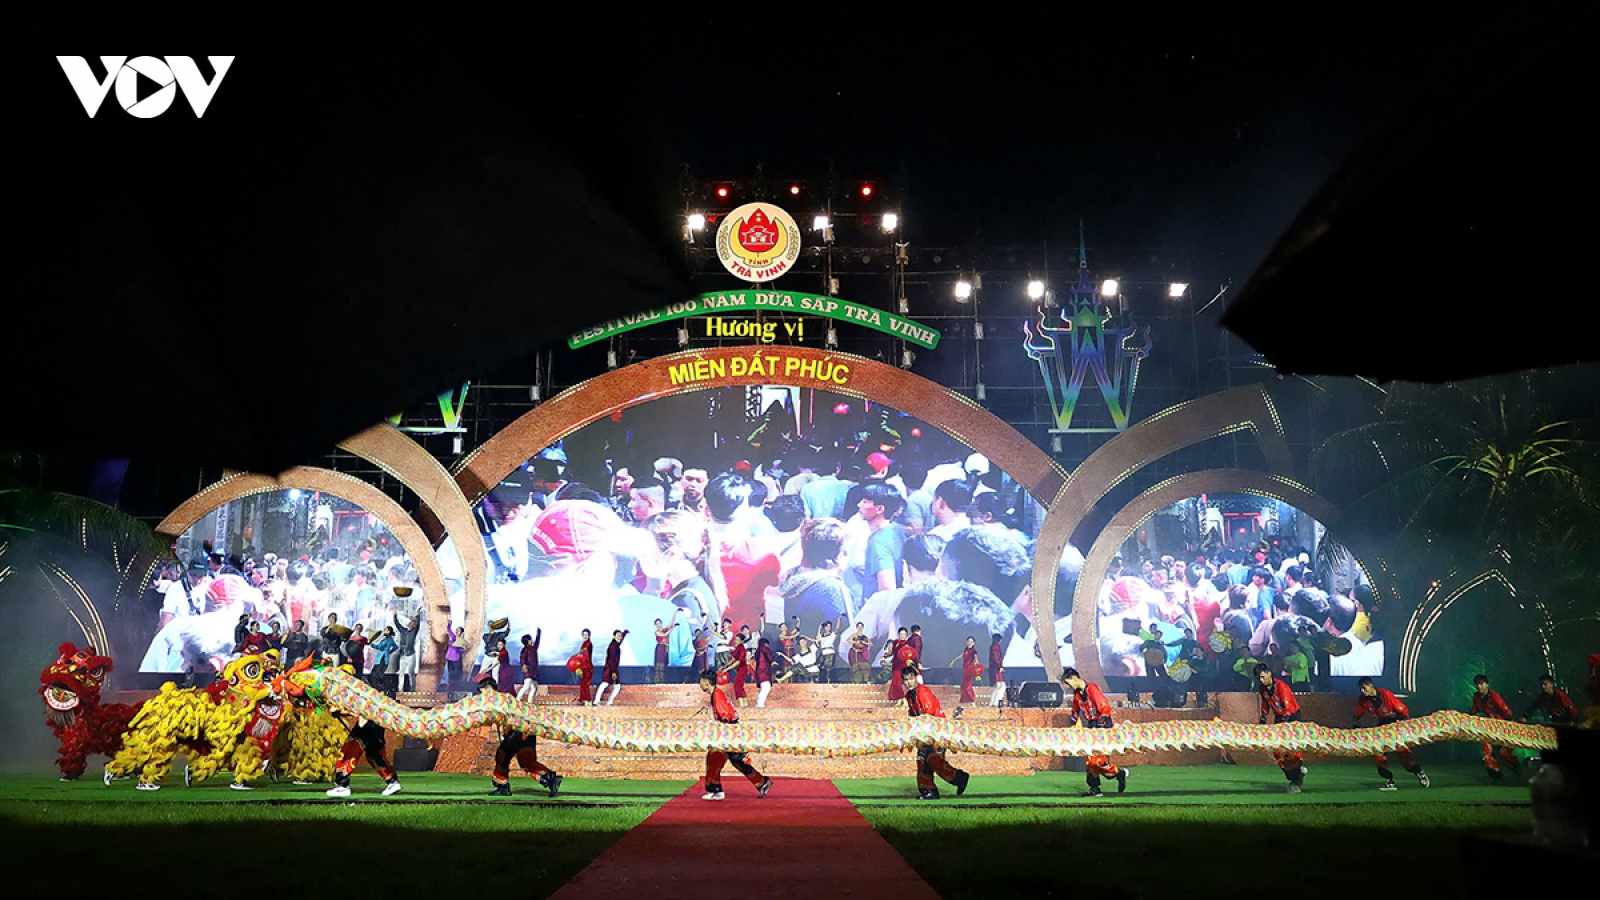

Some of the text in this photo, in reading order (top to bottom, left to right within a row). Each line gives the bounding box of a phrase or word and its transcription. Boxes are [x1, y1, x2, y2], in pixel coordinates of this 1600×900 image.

[731, 260, 787, 279] TRÀ VINH
[665, 300, 697, 316] 100
[844, 304, 881, 326] TRÀ
[889, 317, 936, 345] VINH
[706, 316, 804, 343] Hương vị
[668, 350, 849, 385] MIỀN ĐẤT PHÚC
